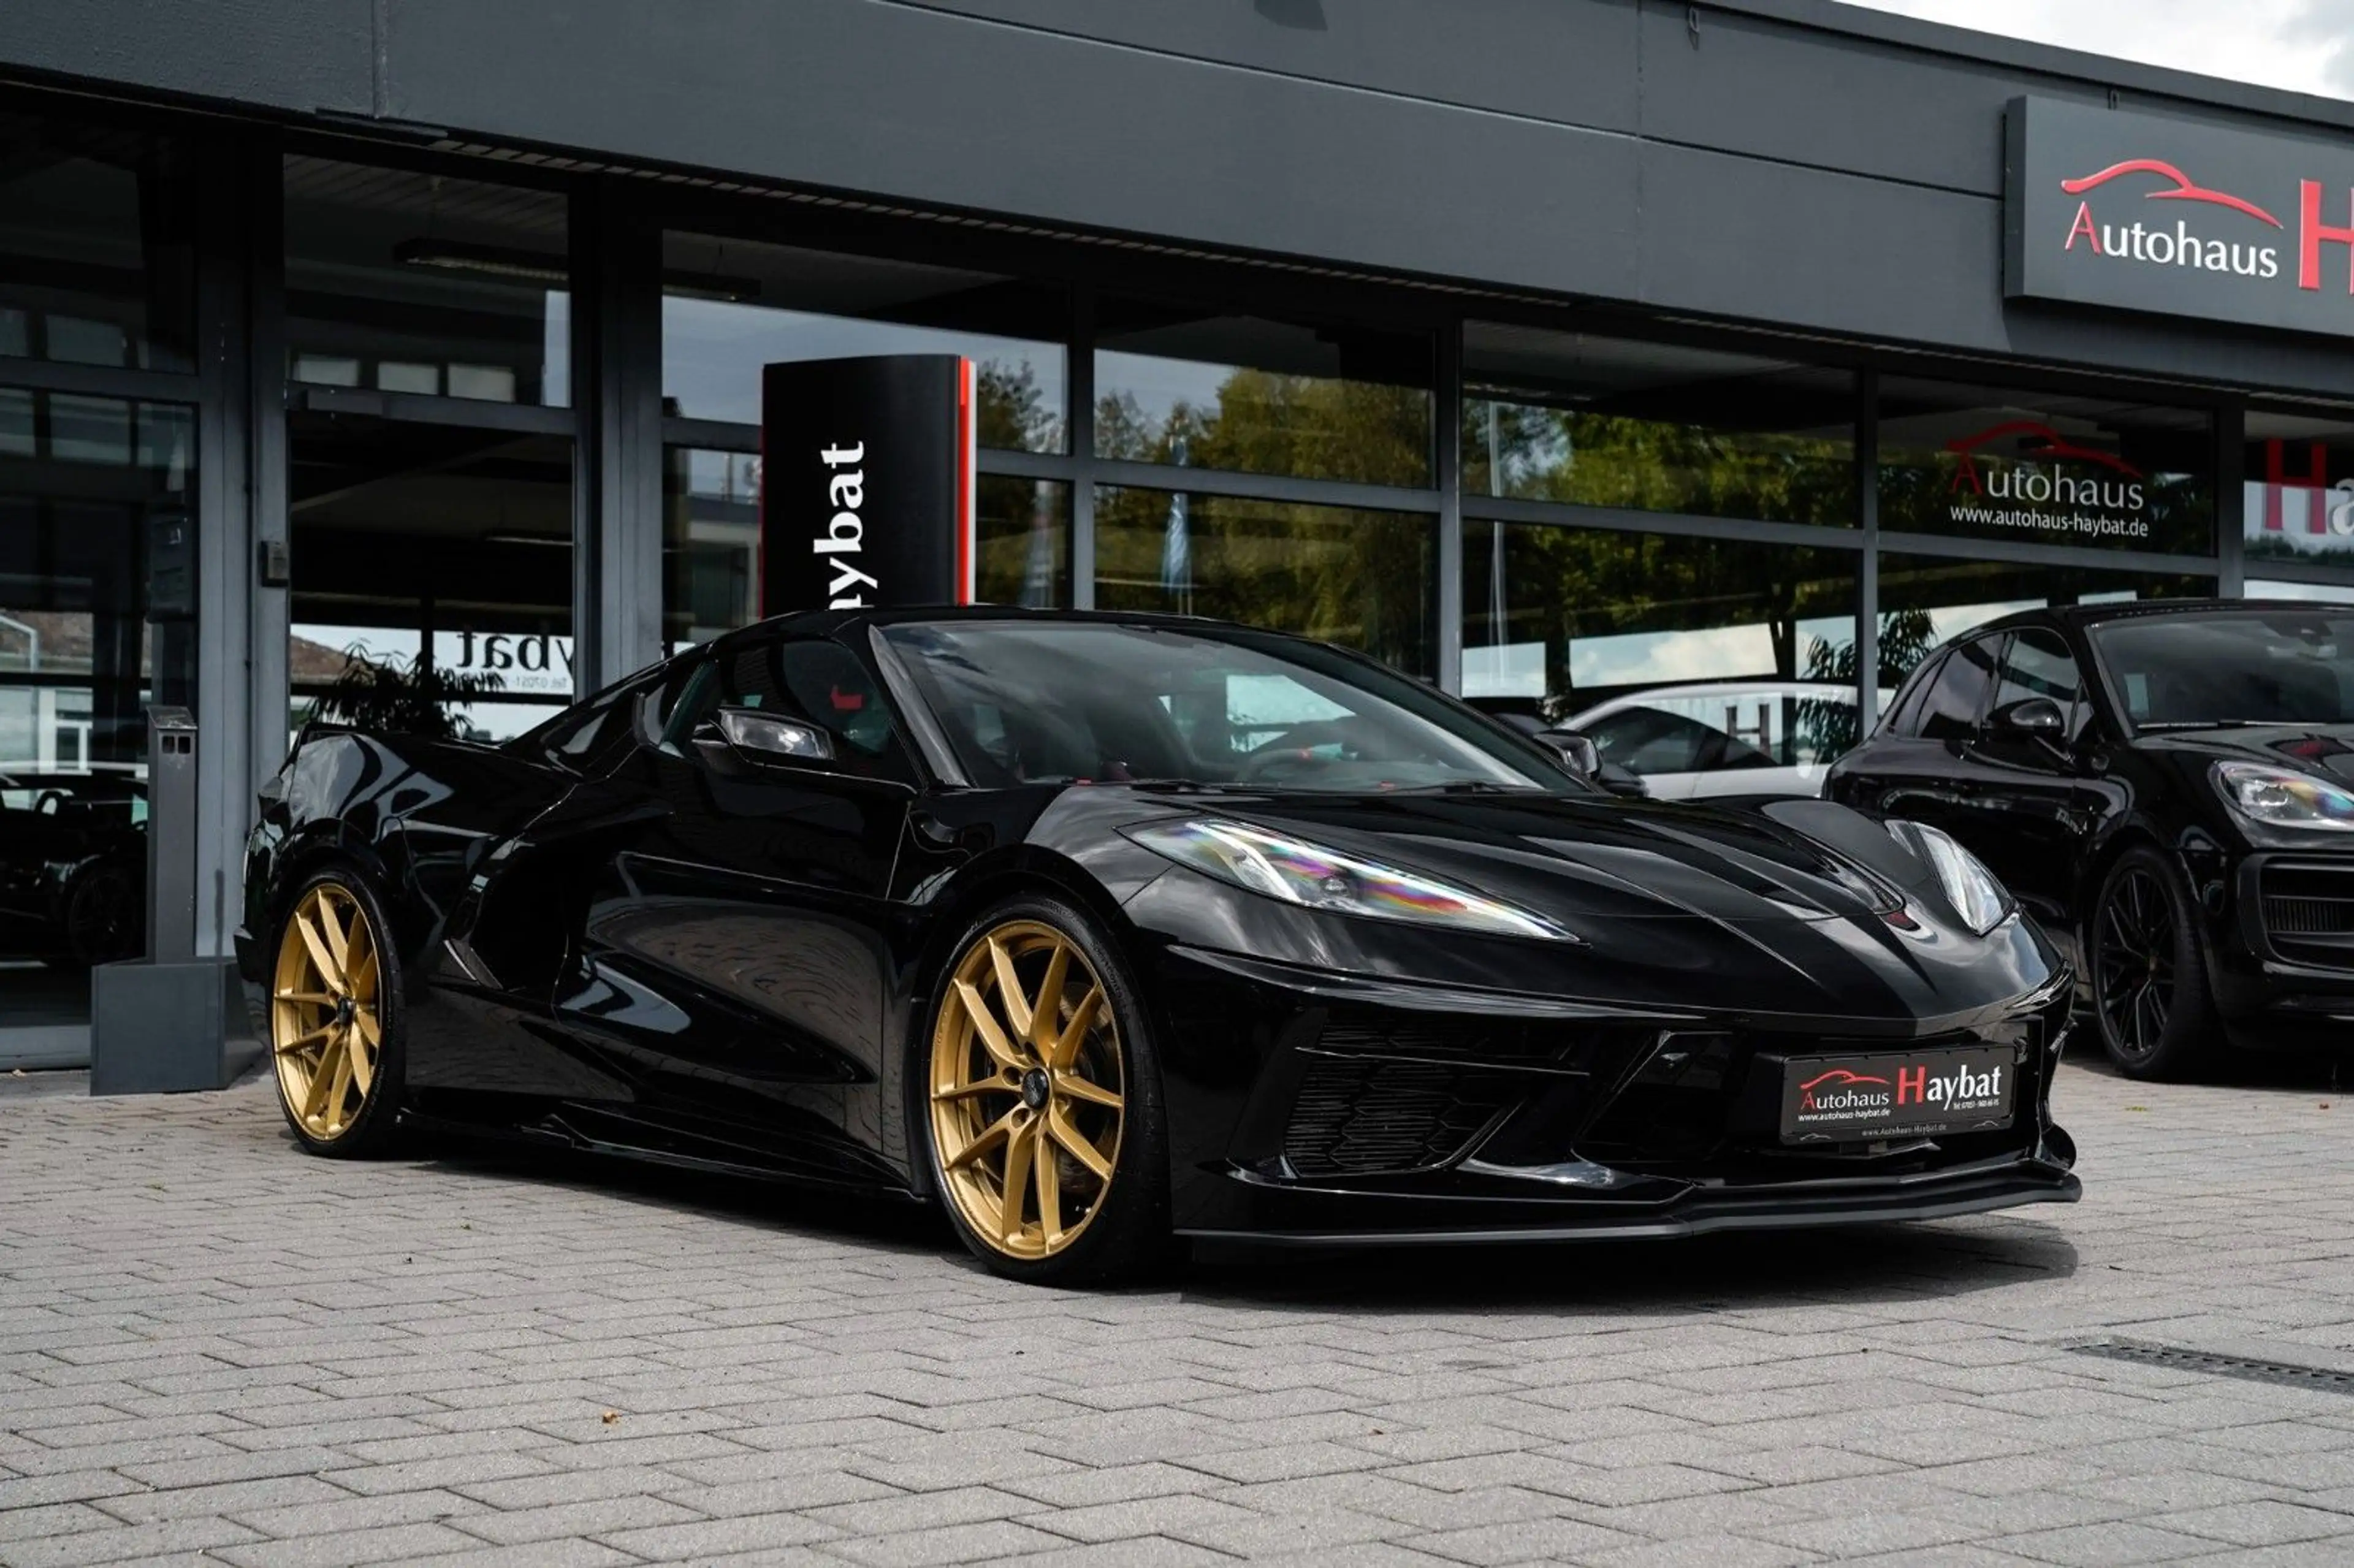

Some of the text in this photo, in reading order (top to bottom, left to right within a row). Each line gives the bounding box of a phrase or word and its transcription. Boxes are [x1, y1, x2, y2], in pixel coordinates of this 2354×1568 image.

[2065, 200, 2278, 278] Autohaus
[1950, 450, 2144, 510] Autohaus
[1950, 505, 2149, 538] www.autohaus-haybat.de
[1800, 1064, 2002, 1111] Autohaus Haybat
[1798, 1108, 1891, 1122] www.autohaus-haybat.de
